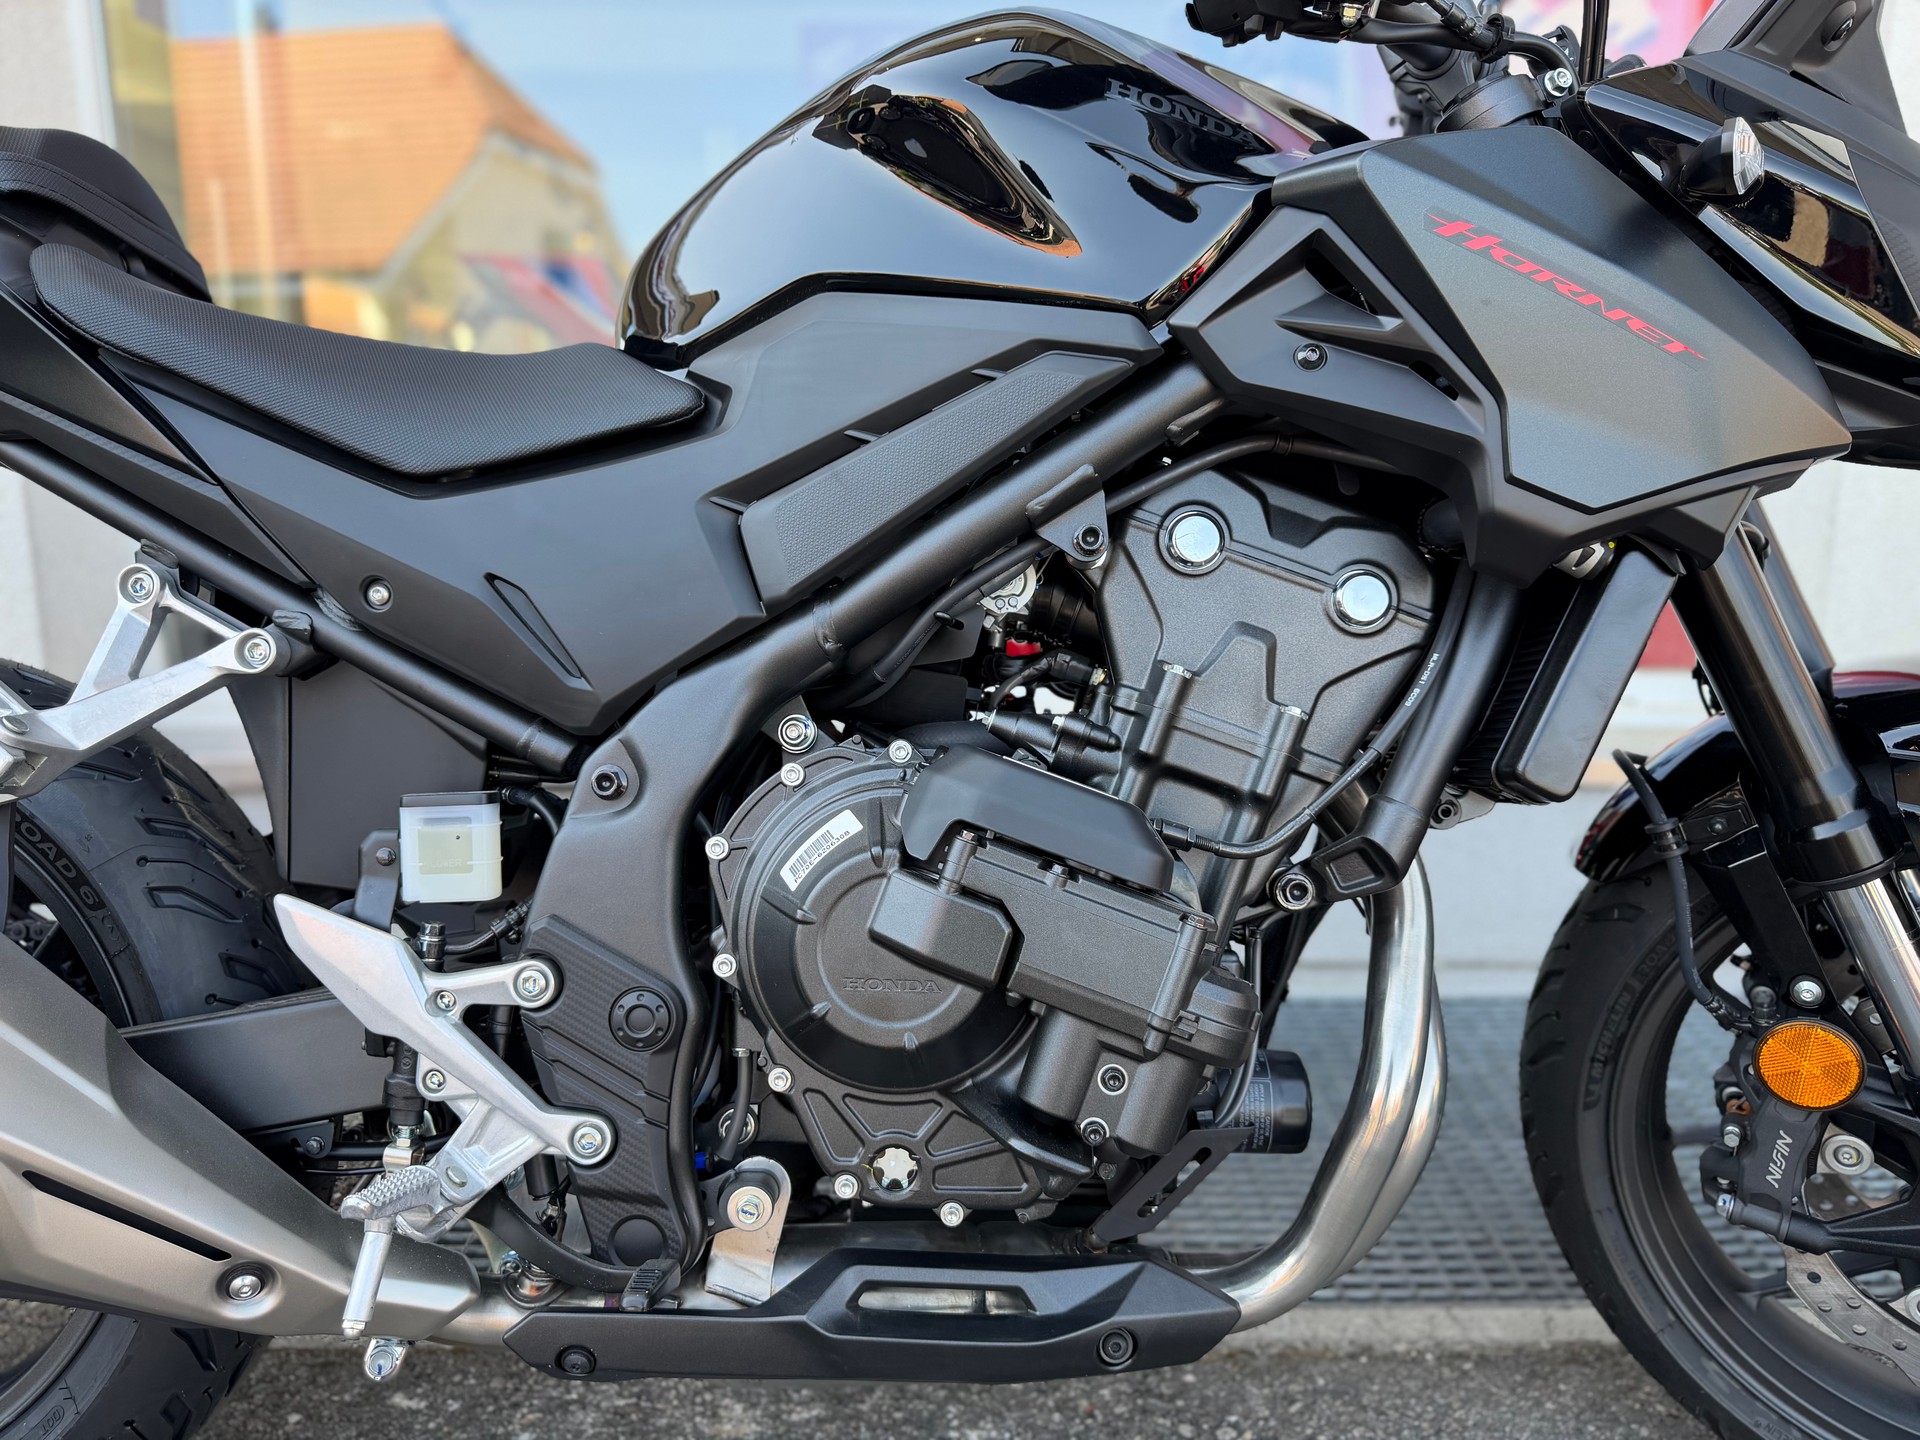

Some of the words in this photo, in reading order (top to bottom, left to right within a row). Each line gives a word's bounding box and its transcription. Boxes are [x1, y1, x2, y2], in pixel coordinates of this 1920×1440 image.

[1104, 78, 1266, 151] HONDA
[1428, 214, 1708, 361] HORNET
[79, 885, 99, 905] 6
[843, 976, 943, 993] HONDA
[1765, 1129, 1793, 1189] NISSIN
